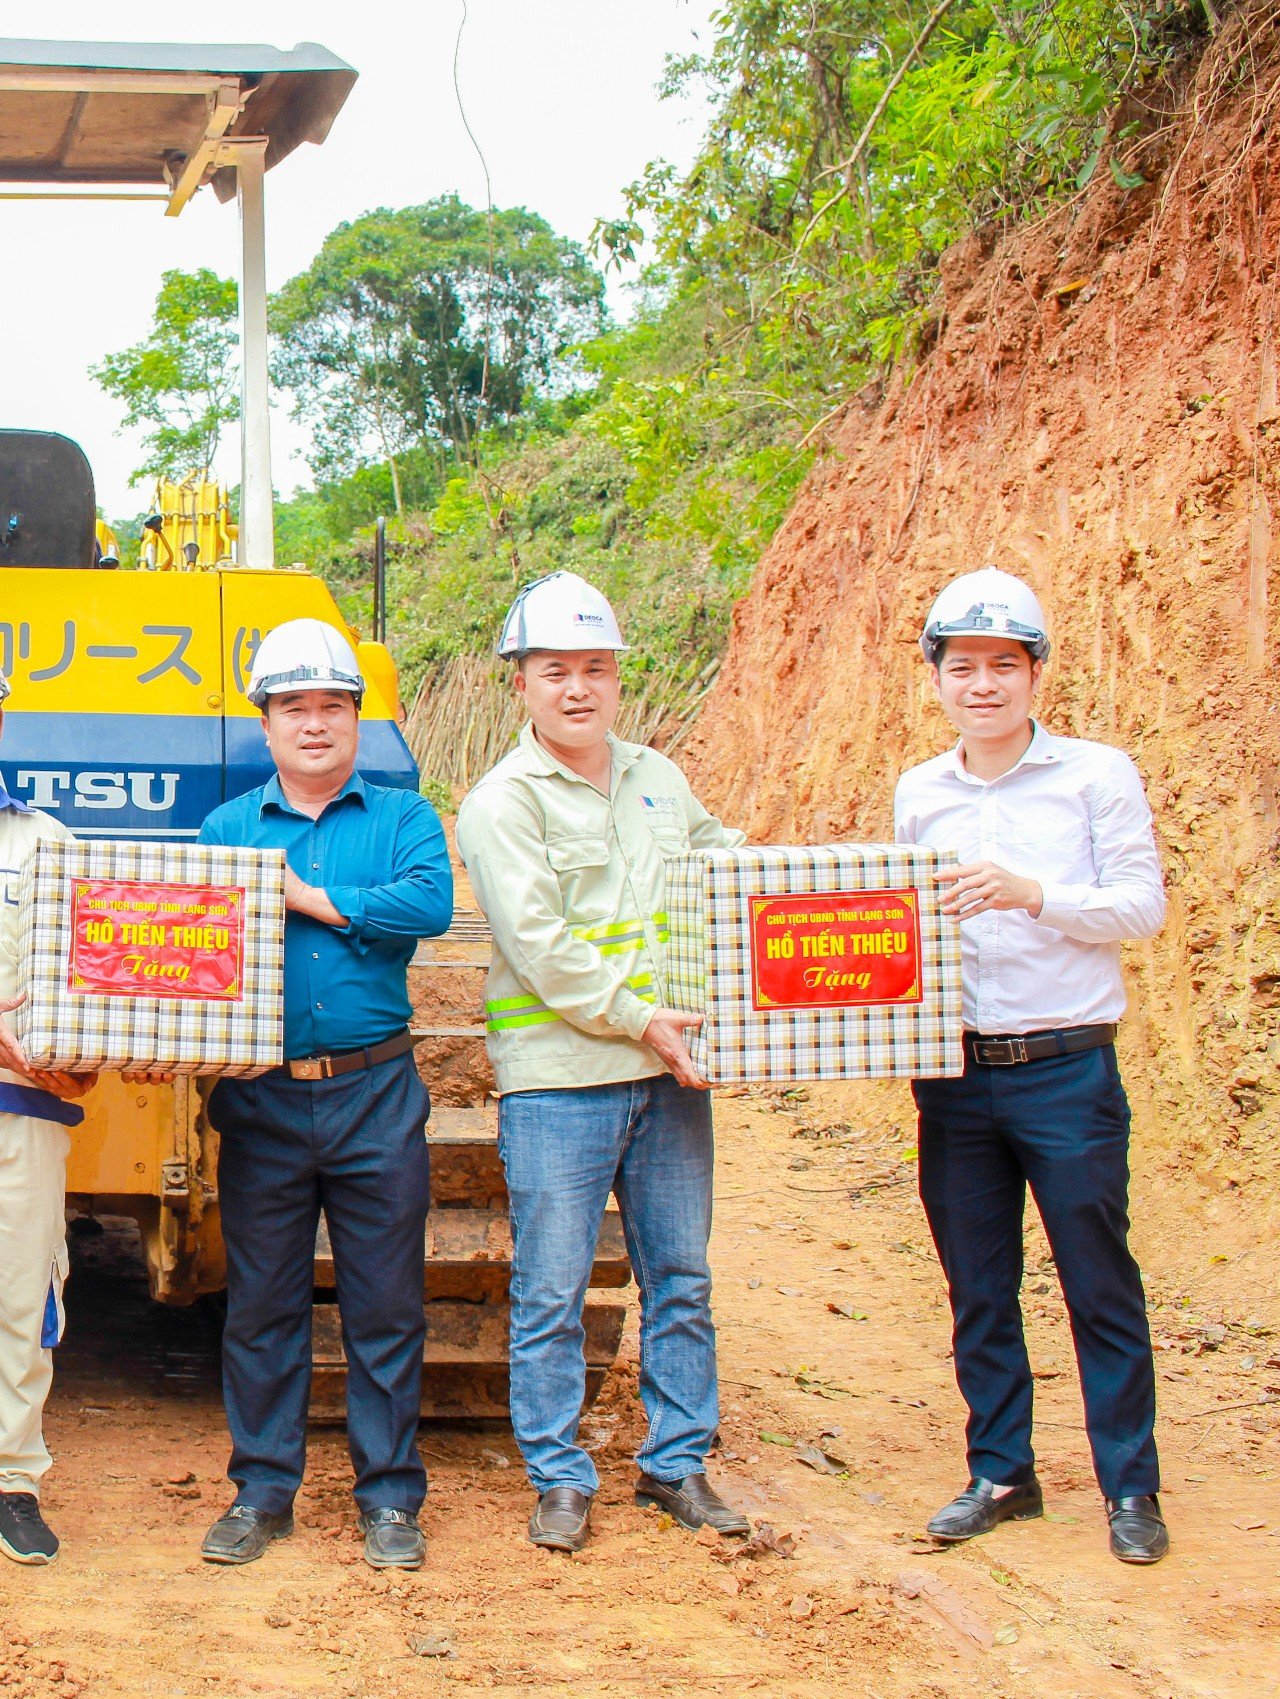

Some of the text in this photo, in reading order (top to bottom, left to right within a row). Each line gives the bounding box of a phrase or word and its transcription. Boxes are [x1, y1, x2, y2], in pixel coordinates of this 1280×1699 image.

[132, 901, 157, 912] UBND
[766, 908, 904, 926] CHỦ TỊCH UBND TỈNH LẠNG SƠN
[86, 915, 229, 954] HỒ TIẾN THIỆU
[766, 927, 907, 959] HỒ TIẾN THIỆU
[121, 953, 191, 982] Tặng
[803, 966, 872, 991] Tặng
